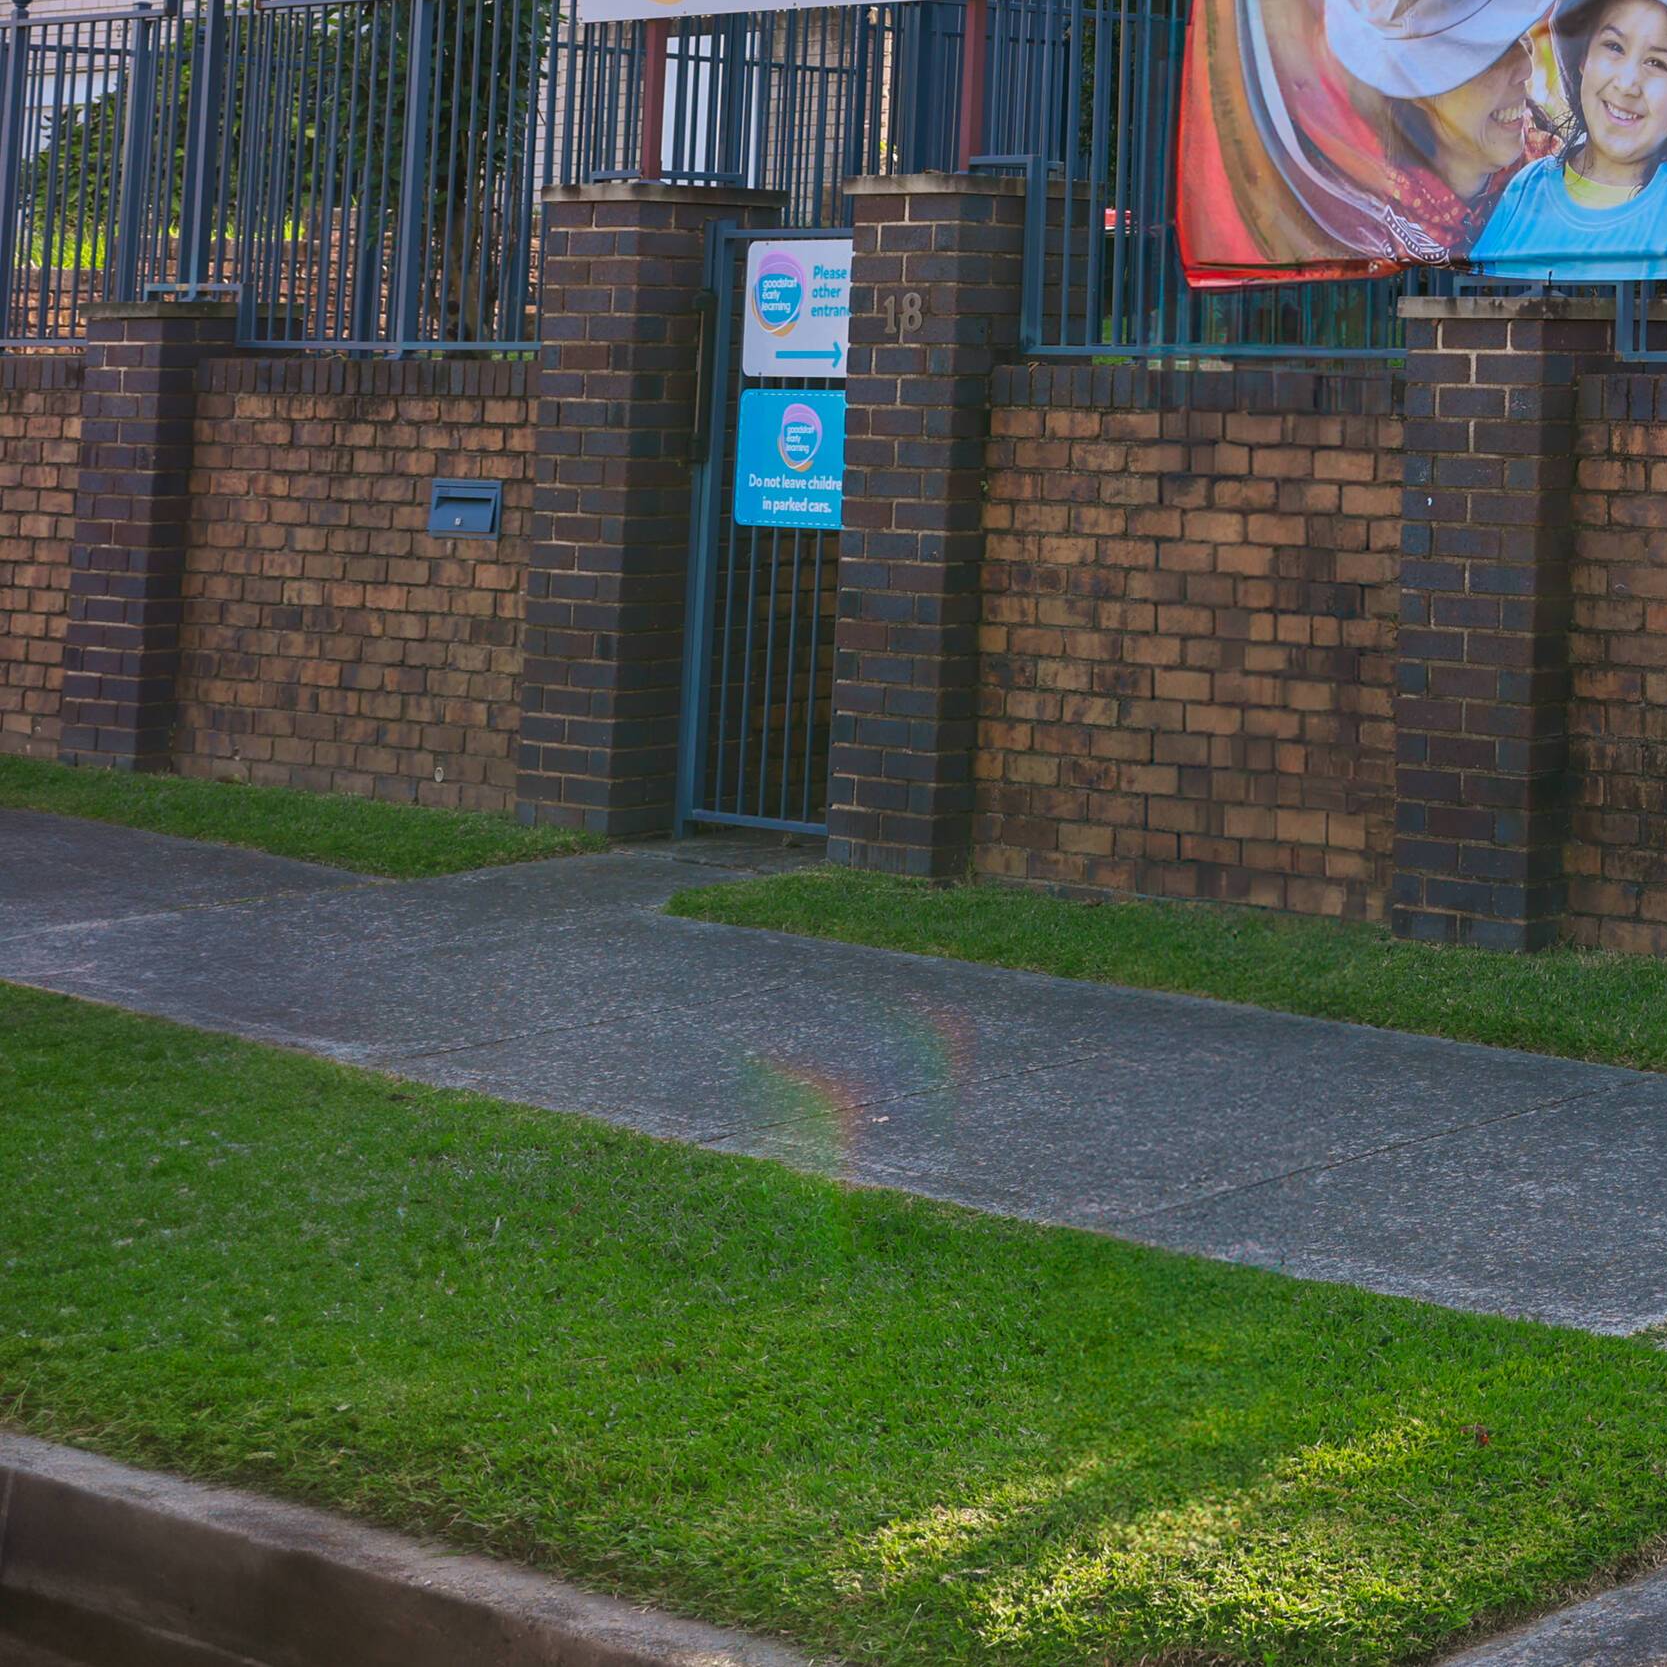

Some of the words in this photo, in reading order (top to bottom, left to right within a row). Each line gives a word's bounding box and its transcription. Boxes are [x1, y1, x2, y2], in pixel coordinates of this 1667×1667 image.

[813, 265, 847, 280] Please
[762, 277, 797, 289] goodstart
[762, 289, 781, 301] early
[812, 284, 841, 299] other
[761, 301, 791, 314] learning
[884, 292, 922, 334] 18
[748, 473, 762, 487] Do
[764, 476, 781, 488] not
[782, 473, 806, 489] leave
[762, 496, 771, 510] in
[773, 496, 808, 514] parked
[808, 502, 832, 513] cars.
